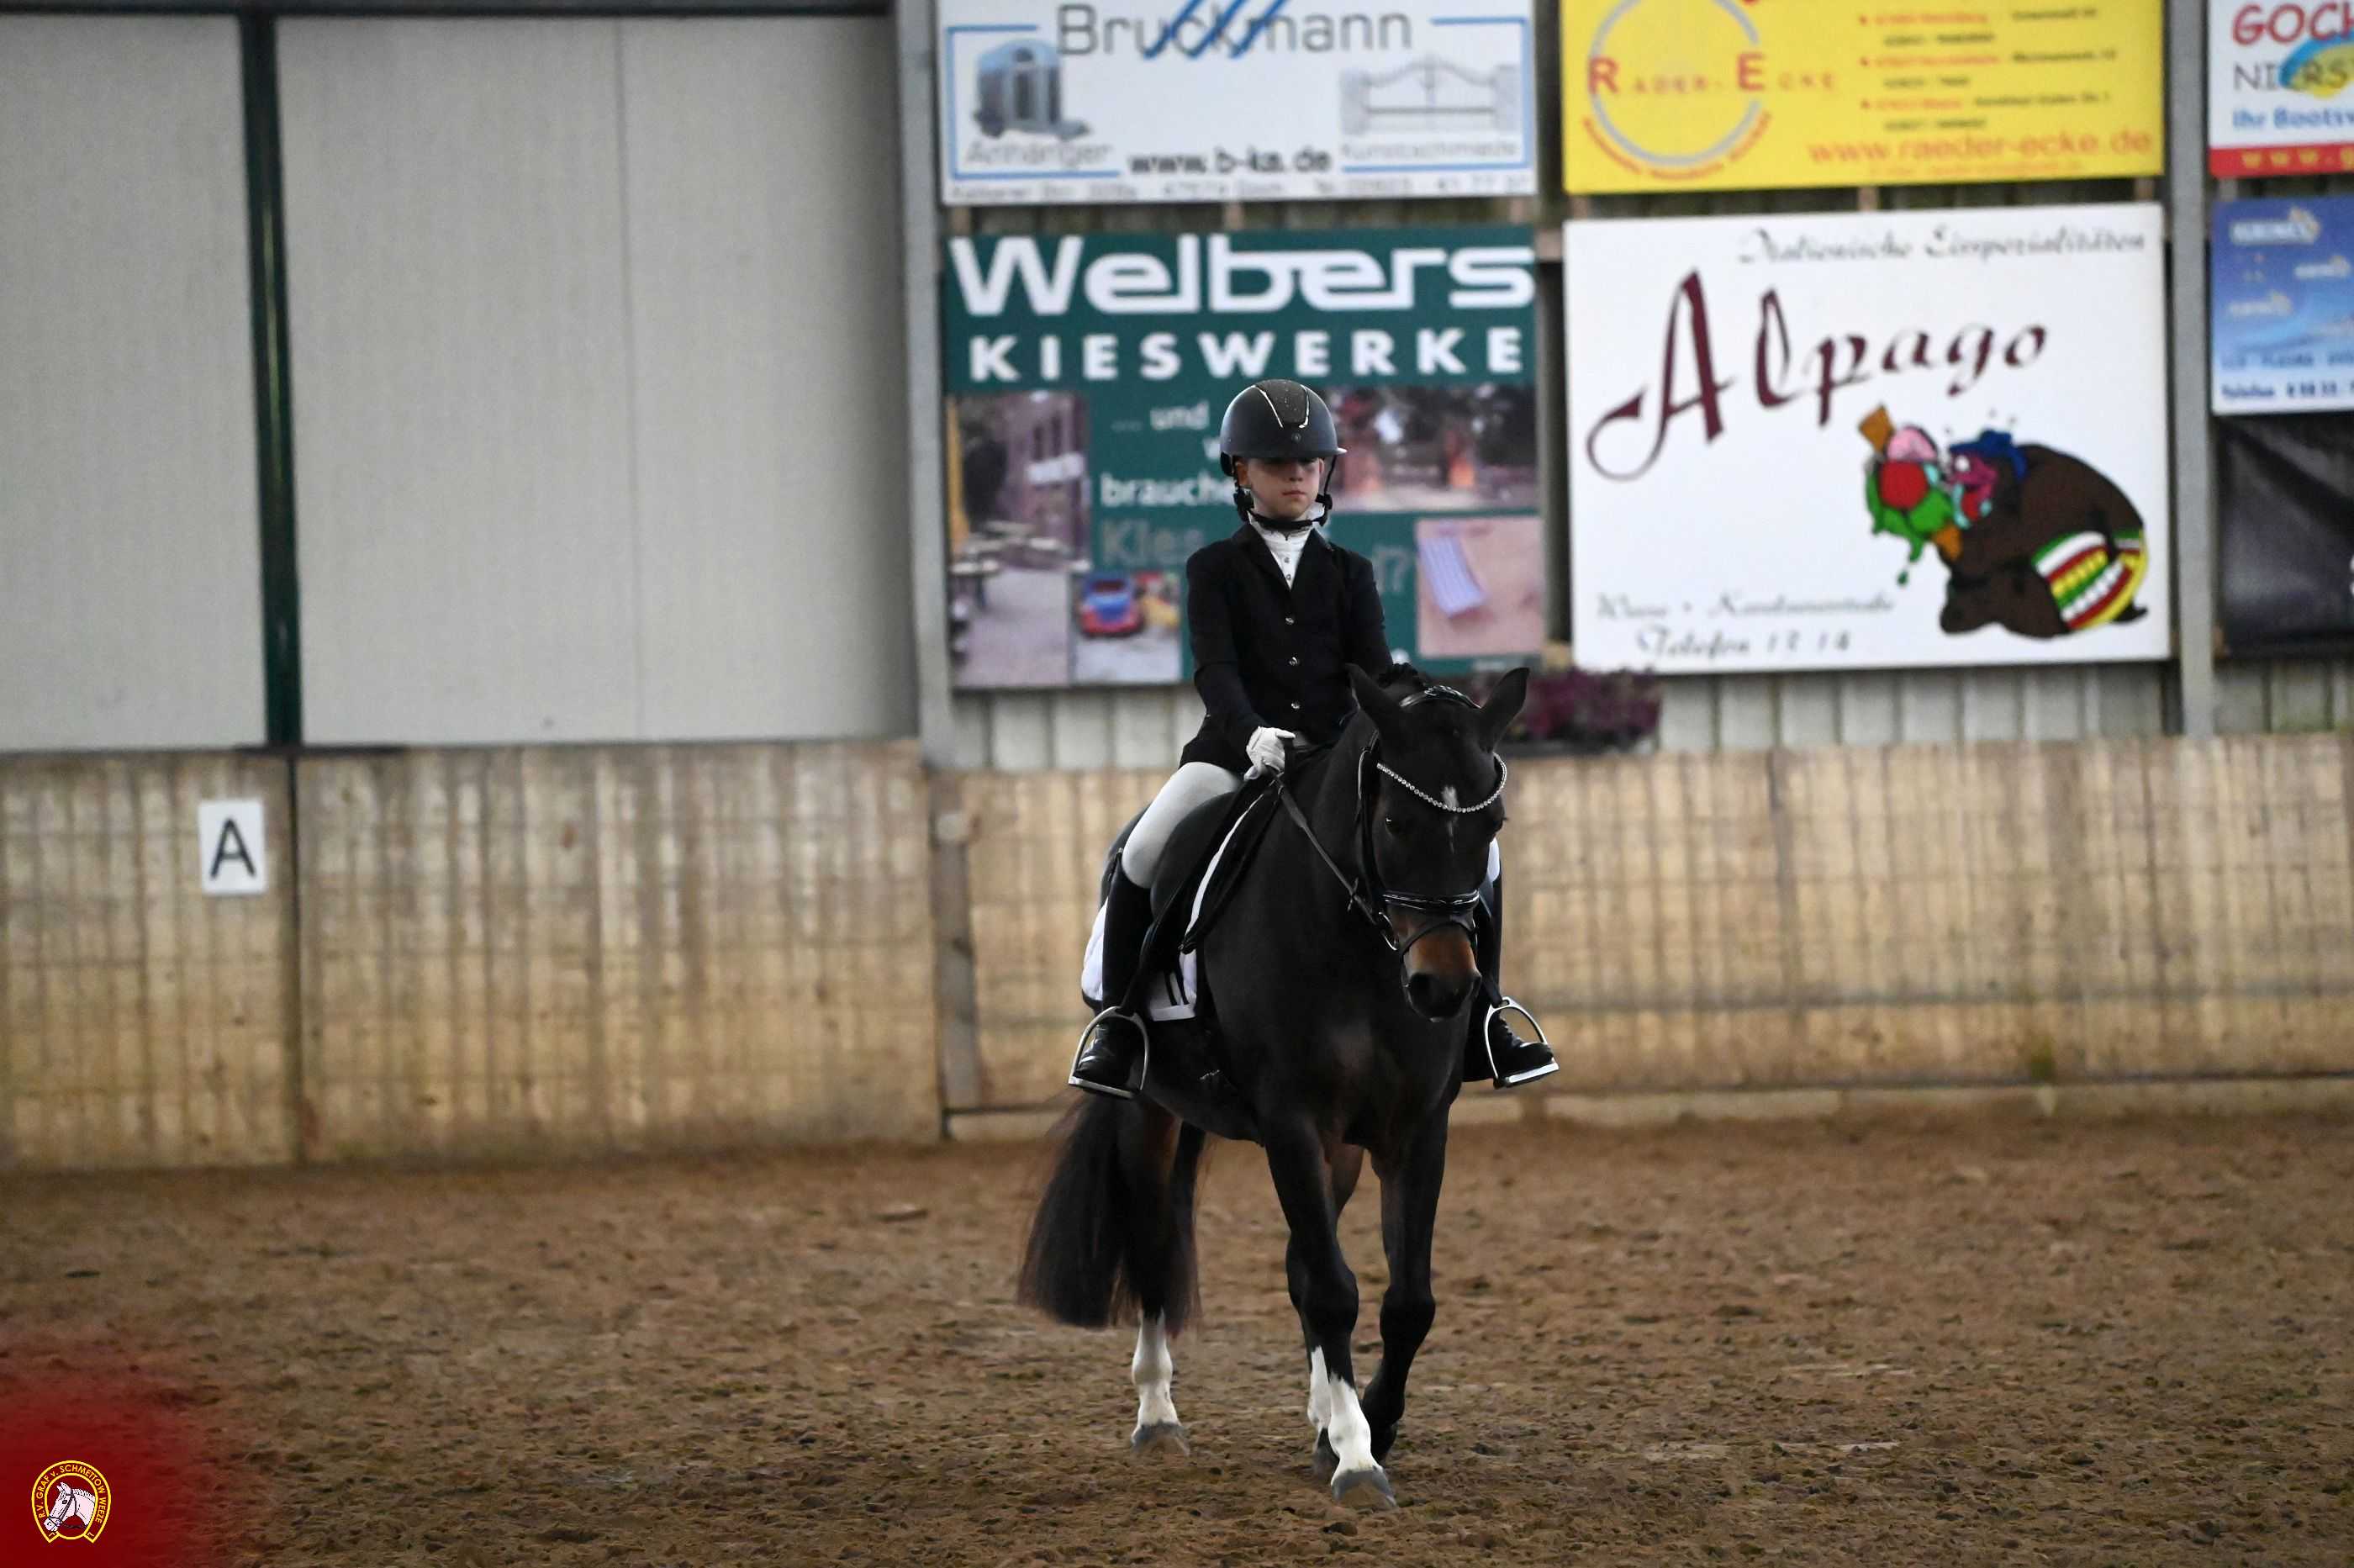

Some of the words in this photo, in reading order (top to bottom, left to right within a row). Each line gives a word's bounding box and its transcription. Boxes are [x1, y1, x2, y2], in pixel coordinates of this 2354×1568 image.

[1057, 3, 1412, 56] Bruckmann
[949, 234, 1536, 315] Welbers
[969, 326, 1523, 383] KIESWERKE
[1586, 267, 2048, 481] Alpago
[1149, 400, 1211, 431] und
[209, 818, 256, 878] A
